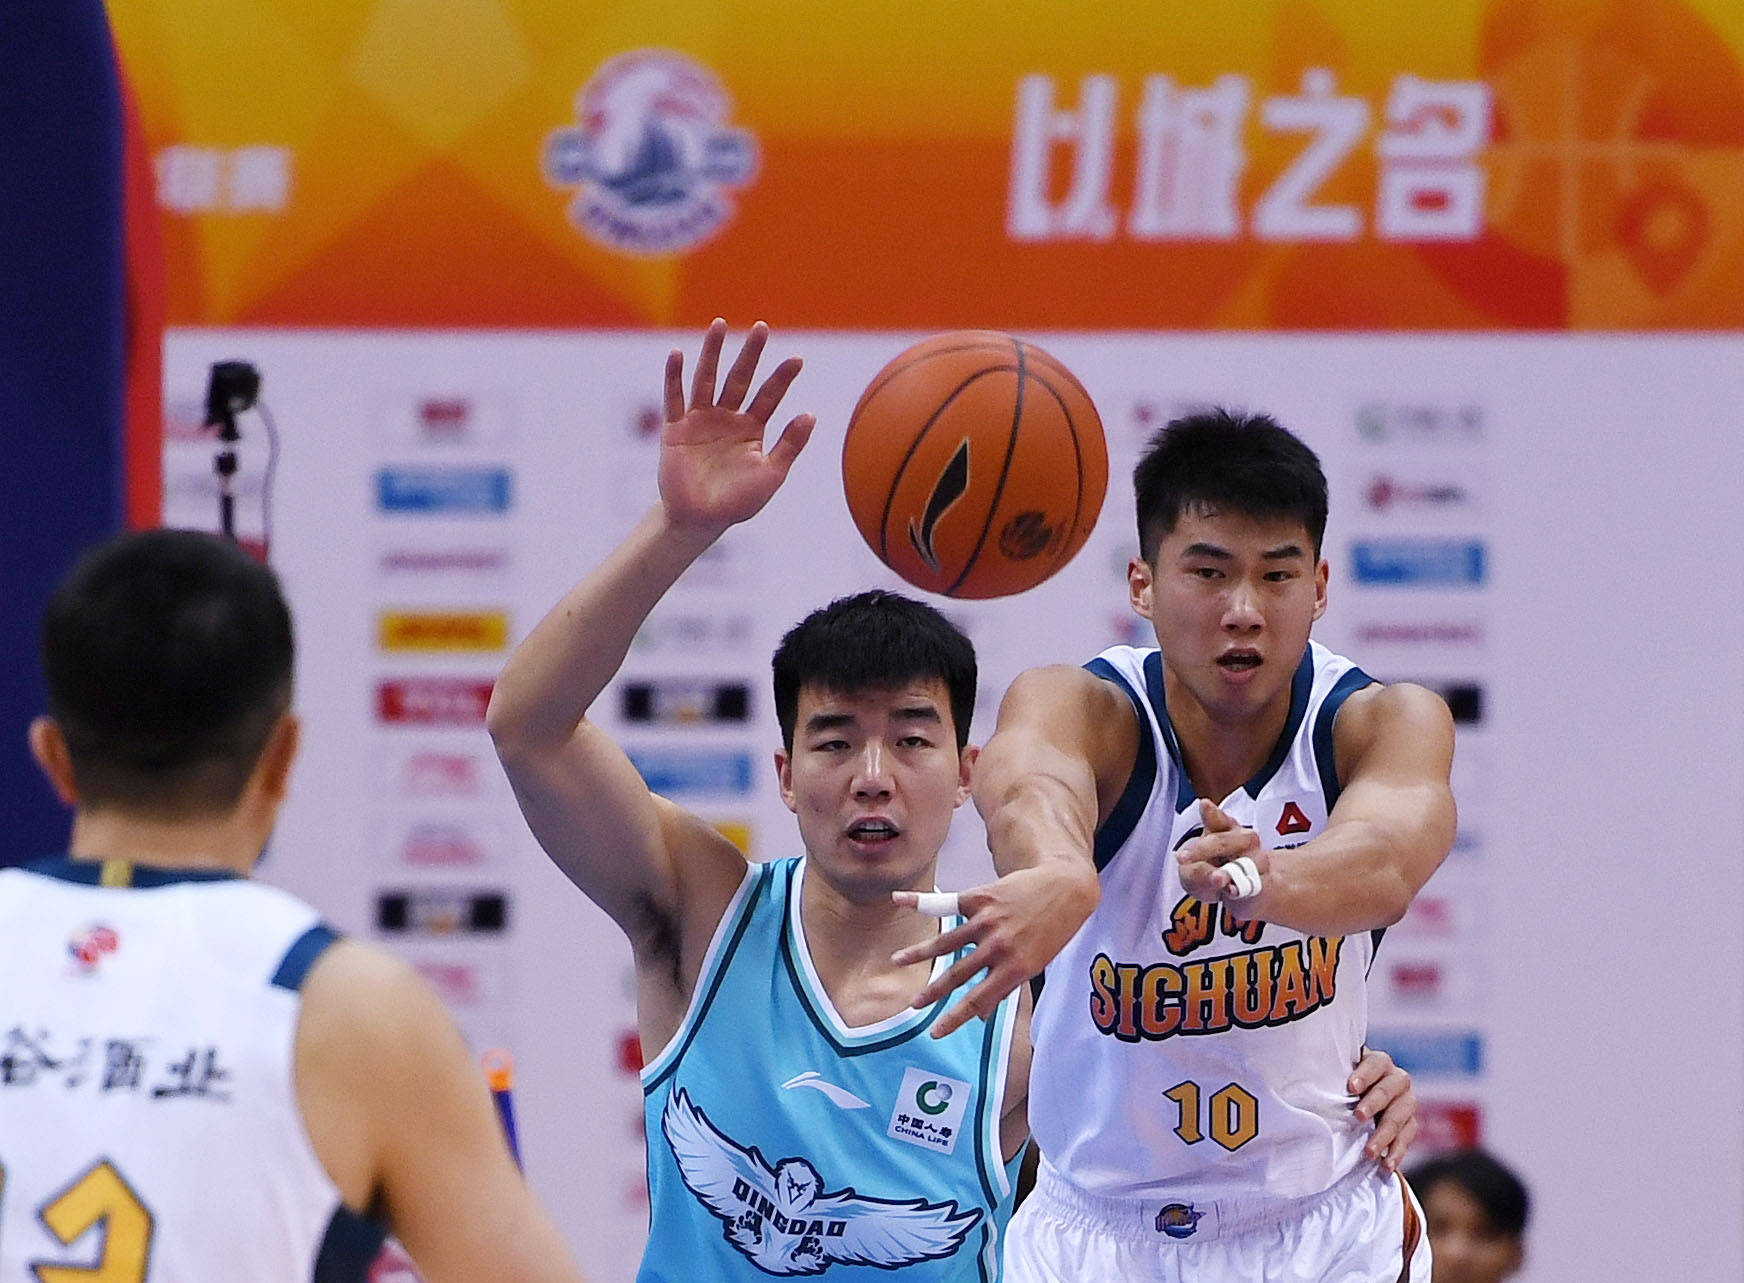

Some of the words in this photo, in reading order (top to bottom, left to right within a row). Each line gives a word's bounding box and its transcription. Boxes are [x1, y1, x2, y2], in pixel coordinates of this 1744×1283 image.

[1007, 69, 1495, 242] 以城之名
[1089, 935, 1345, 1043] SICHUAN
[895, 1125, 925, 1139] CHINA
[927, 1135, 949, 1146] LIFE
[897, 1114, 952, 1138] 中国人寿
[1162, 1080, 1259, 1153] 10
[731, 1176, 848, 1238] QINGDAO
